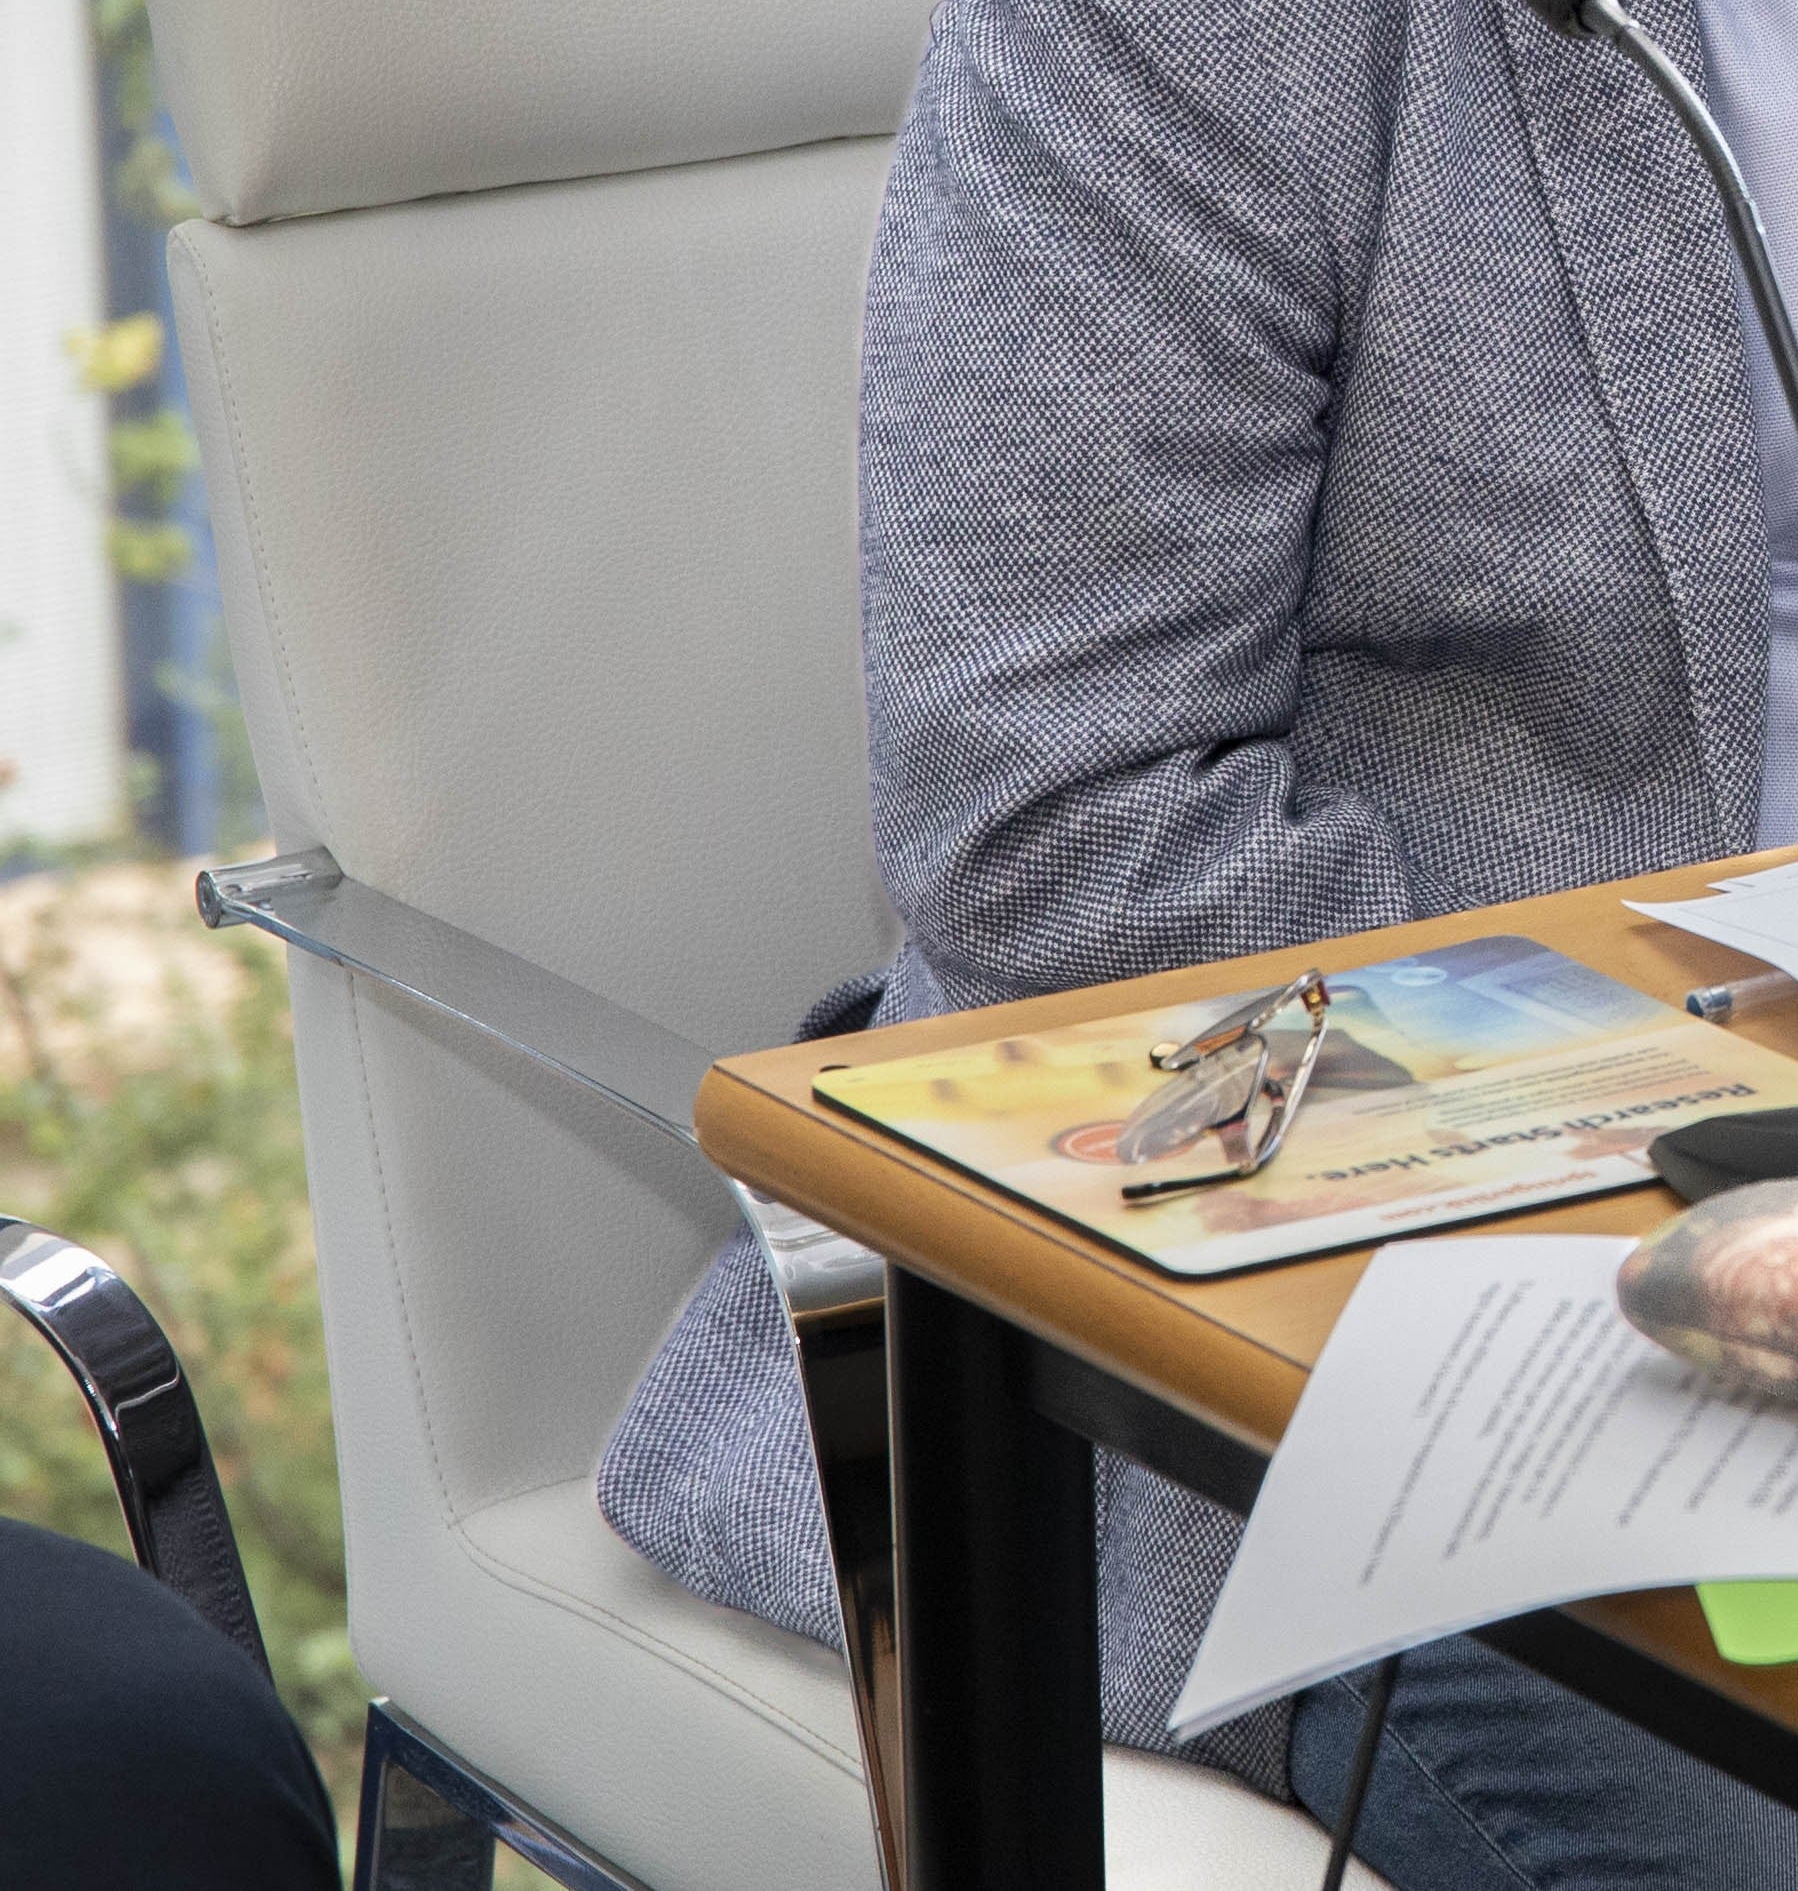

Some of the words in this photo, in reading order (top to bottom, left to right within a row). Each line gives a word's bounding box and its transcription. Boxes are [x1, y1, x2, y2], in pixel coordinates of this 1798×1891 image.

[1563, 1082, 1758, 1131] Research
[1429, 1125, 1563, 1159] Starts
[1304, 1154, 1430, 1181] Here.
